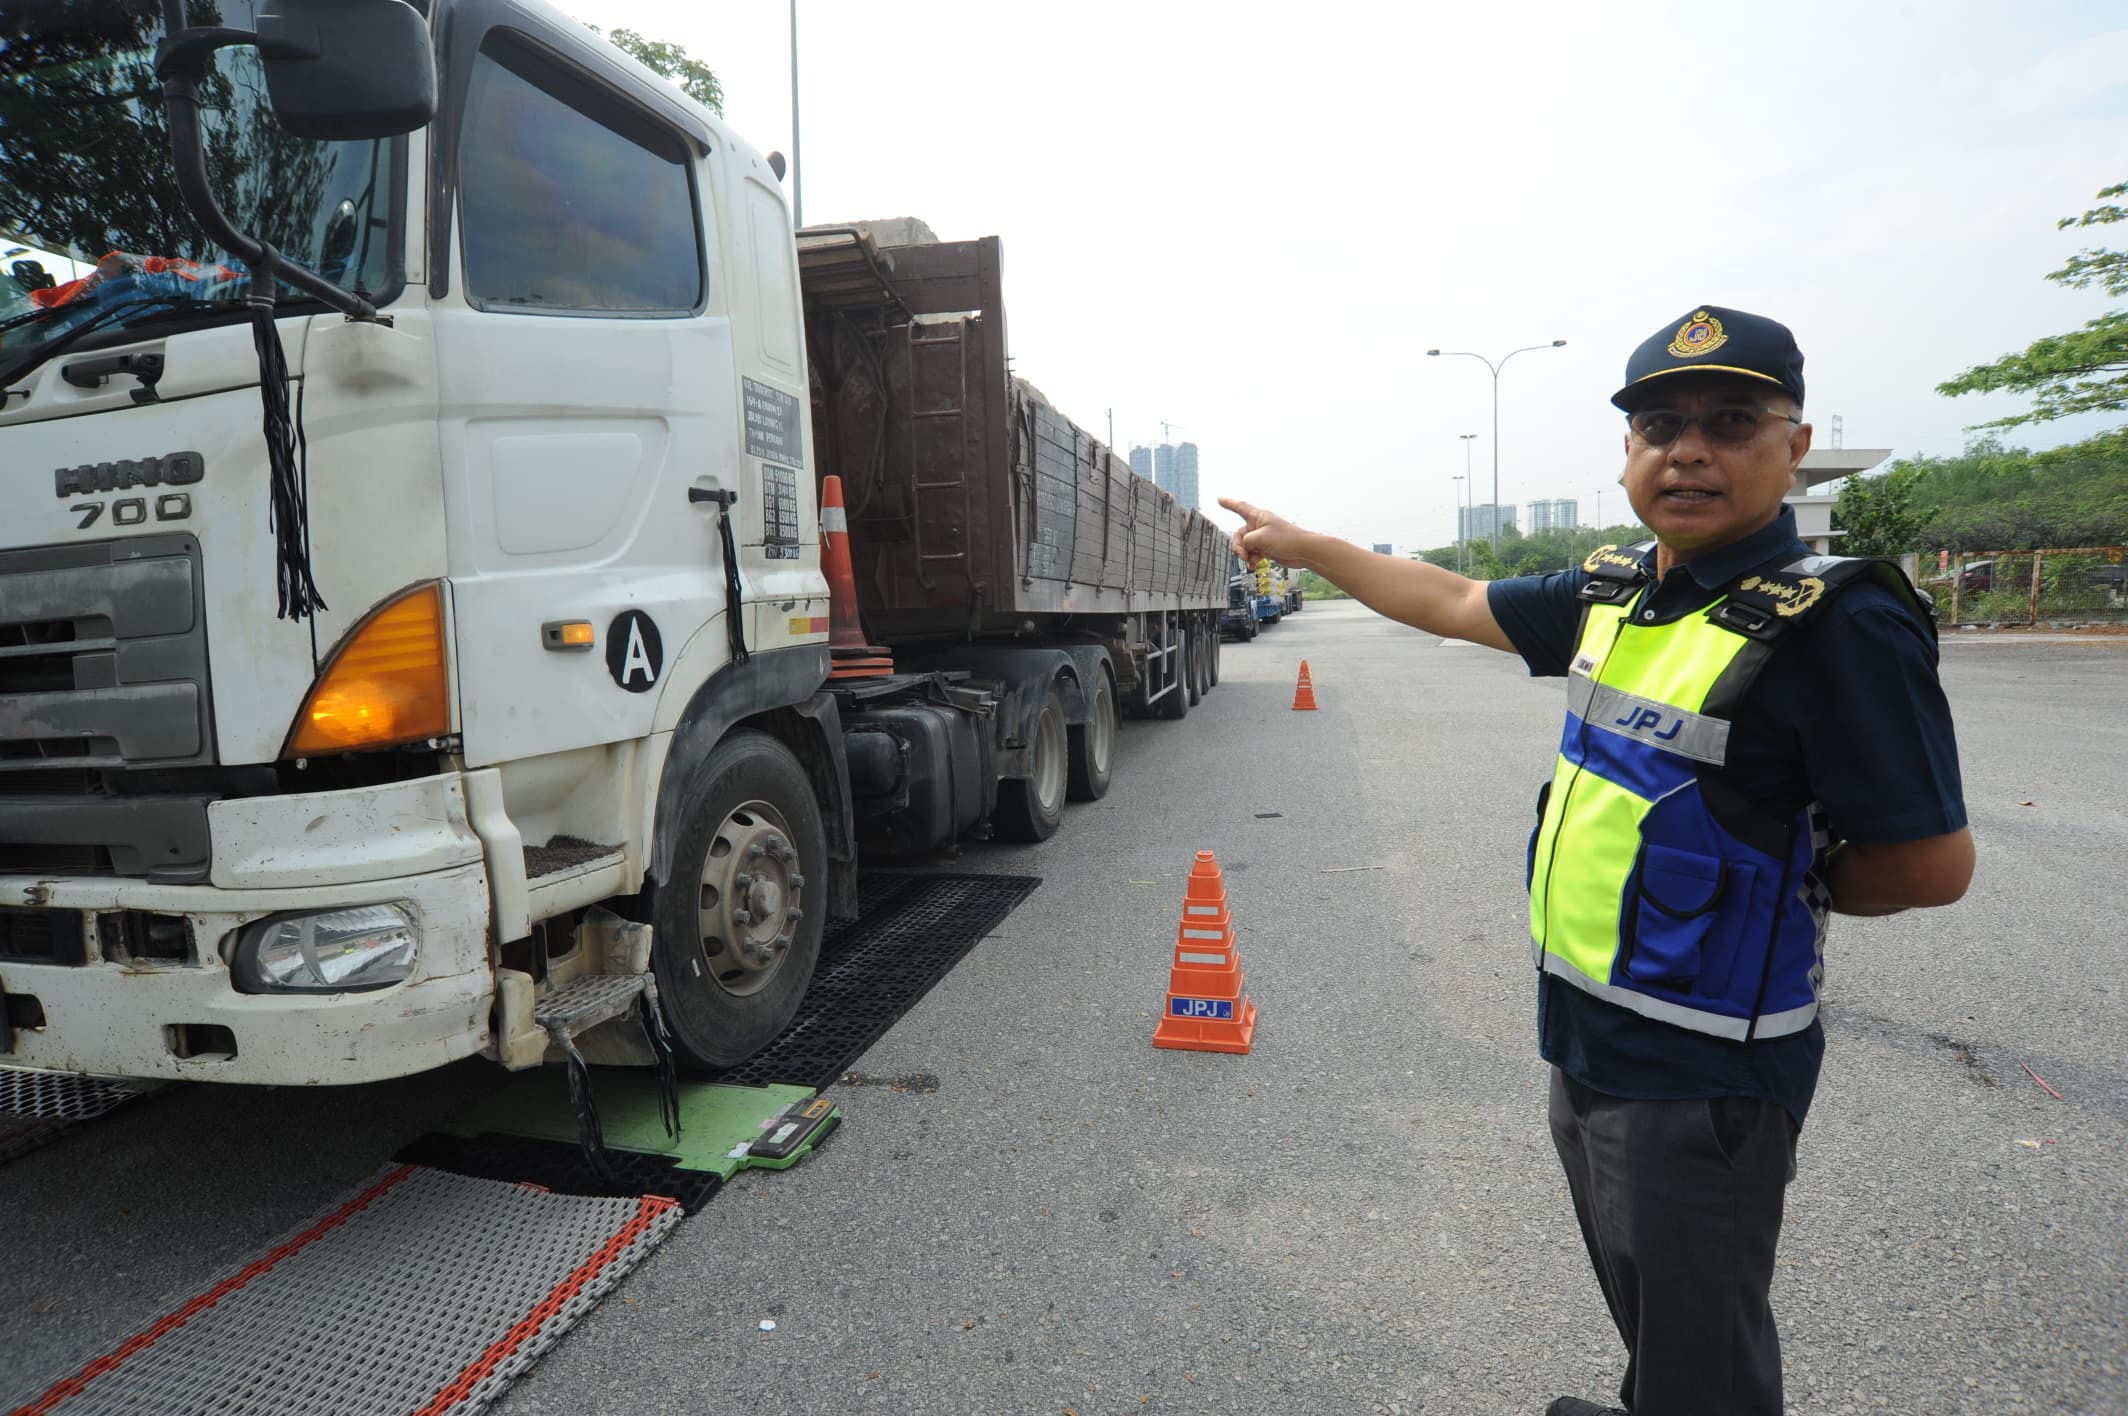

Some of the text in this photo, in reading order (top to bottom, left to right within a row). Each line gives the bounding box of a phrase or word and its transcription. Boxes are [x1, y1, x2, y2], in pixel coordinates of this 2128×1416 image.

[55, 451, 205, 498] HINO
[70, 493, 192, 529] 700
[622, 616, 655, 684] A
[1616, 706, 1684, 740] JPJ
[1183, 1000, 1218, 1017] JPJ
